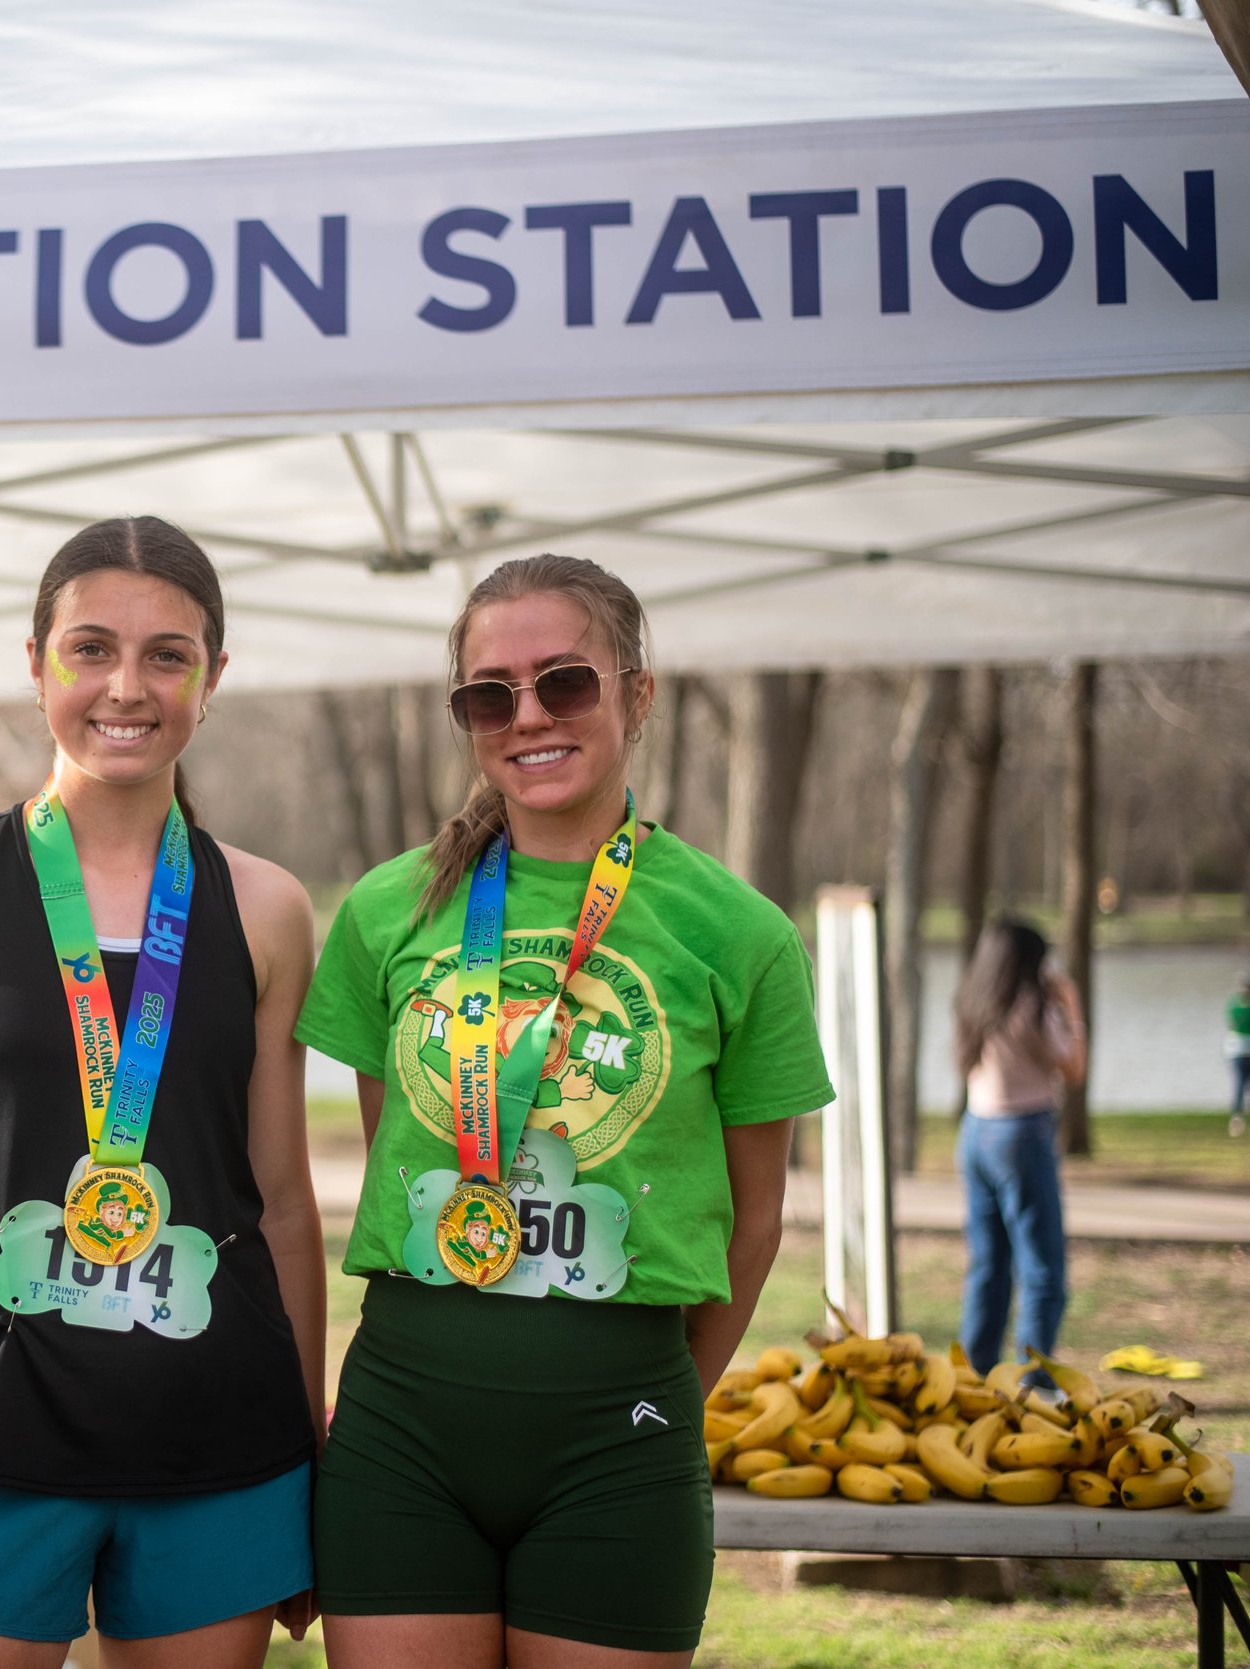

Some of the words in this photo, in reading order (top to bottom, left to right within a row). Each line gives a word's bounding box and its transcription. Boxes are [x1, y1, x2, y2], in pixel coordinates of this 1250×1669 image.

[417, 170, 1219, 334] STATION
[615, 841, 629, 863] 5K
[144, 893, 188, 966] BFT
[469, 897, 483, 947] TRINITY
[482, 906, 497, 947] FALLS
[580, 899, 599, 942] FALLS
[508, 938, 629, 985] SHAMOCK
[619, 983, 654, 1028] RUN
[136, 991, 165, 1049] 2025
[467, 998, 482, 1017] 5K
[75, 995, 100, 1075] SHAMROCK
[88, 1077, 105, 1109] RUN
[473, 1044, 489, 1074] RUN
[581, 1030, 633, 1071] 5K
[115, 1058, 138, 1119] TRINITY
[130, 1078, 150, 1125] FALLS
[459, 1057, 476, 1135] MCKINNEY
[475, 1078, 491, 1160] SHAMROCK
[70, 1173, 104, 1206] MCKINNEY
[105, 1171, 146, 1194] SHAMROCK
[141, 1190, 155, 1209] RUN
[130, 1211, 146, 1224] 5K
[492, 1231, 507, 1247] 5K
[508, 1198, 586, 1260] 50
[44, 1225, 175, 1299] 1514
[47, 1293, 78, 1306] FALLS
[48, 1284, 90, 1298] TRINITY
